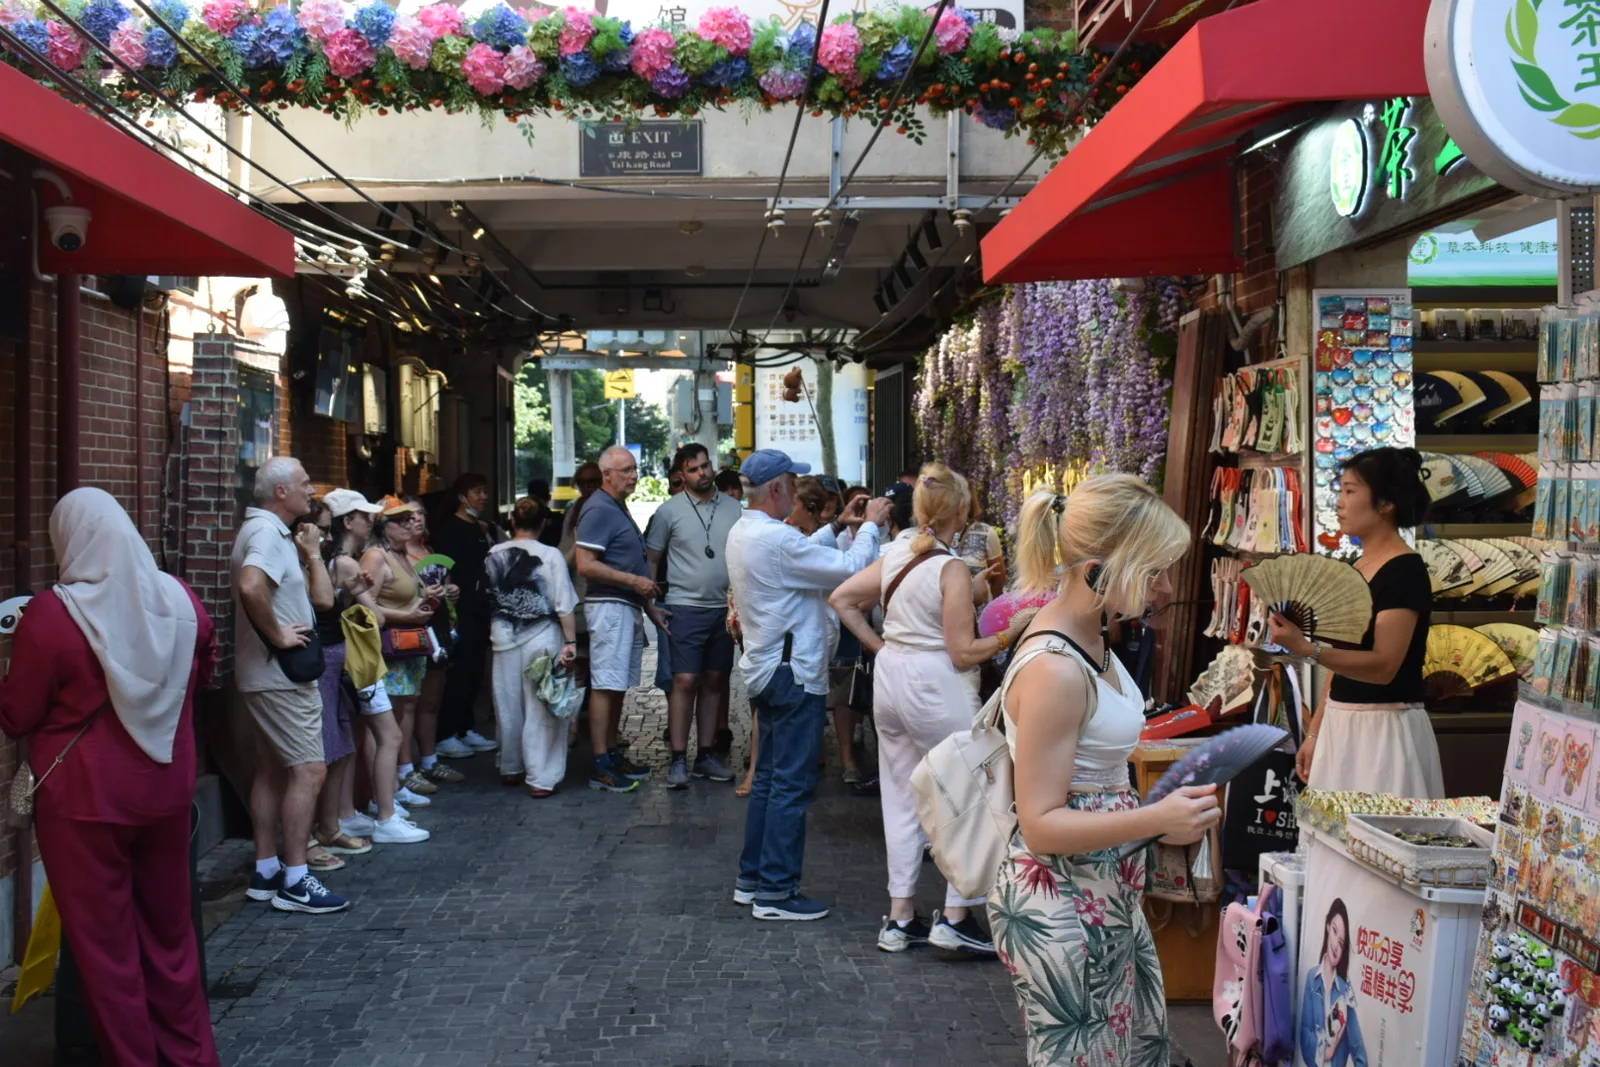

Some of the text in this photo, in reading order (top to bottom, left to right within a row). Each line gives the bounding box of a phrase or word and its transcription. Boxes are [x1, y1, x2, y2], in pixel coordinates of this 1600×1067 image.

[631, 131, 671, 144] EXIT
[649, 160, 671, 169] Road
[1446, 241, 1511, 254] 草本科技
[1357, 925, 1405, 971] 快乐分享
